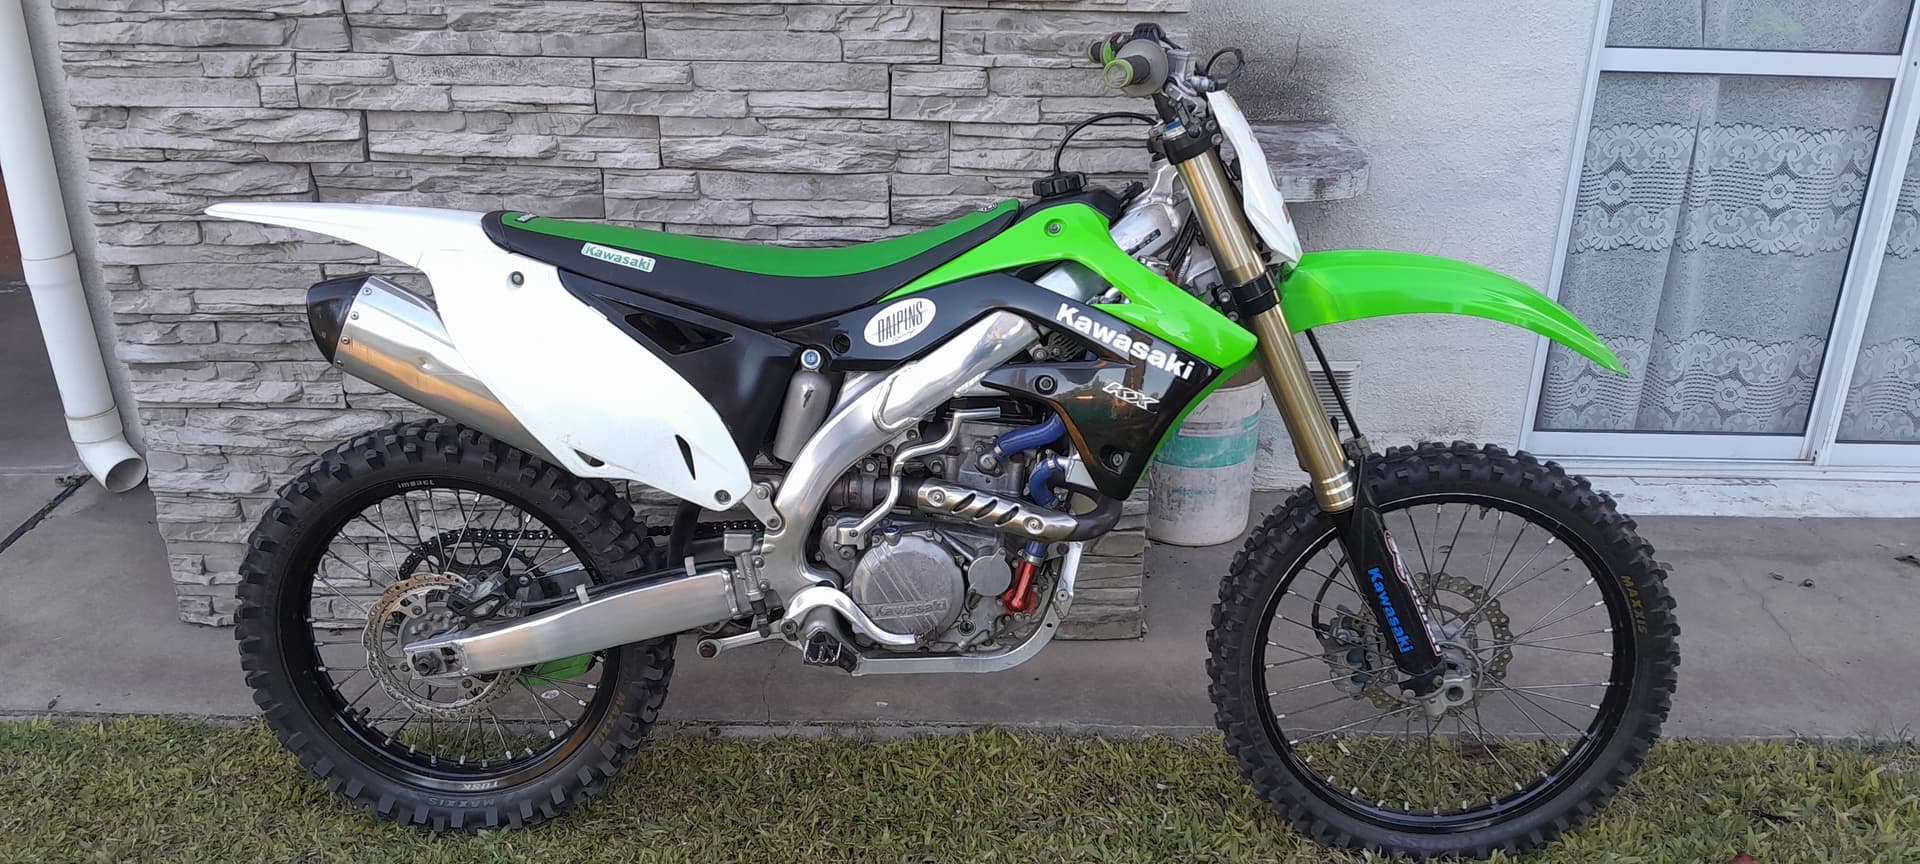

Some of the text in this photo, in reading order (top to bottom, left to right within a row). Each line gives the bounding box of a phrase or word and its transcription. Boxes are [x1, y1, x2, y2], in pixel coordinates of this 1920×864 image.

[585, 244, 652, 271] Kawasaki
[1056, 303, 1195, 380] Kawasaki
[873, 600, 947, 618] Kawasaki
[1367, 566, 1415, 654] Kawasaki
